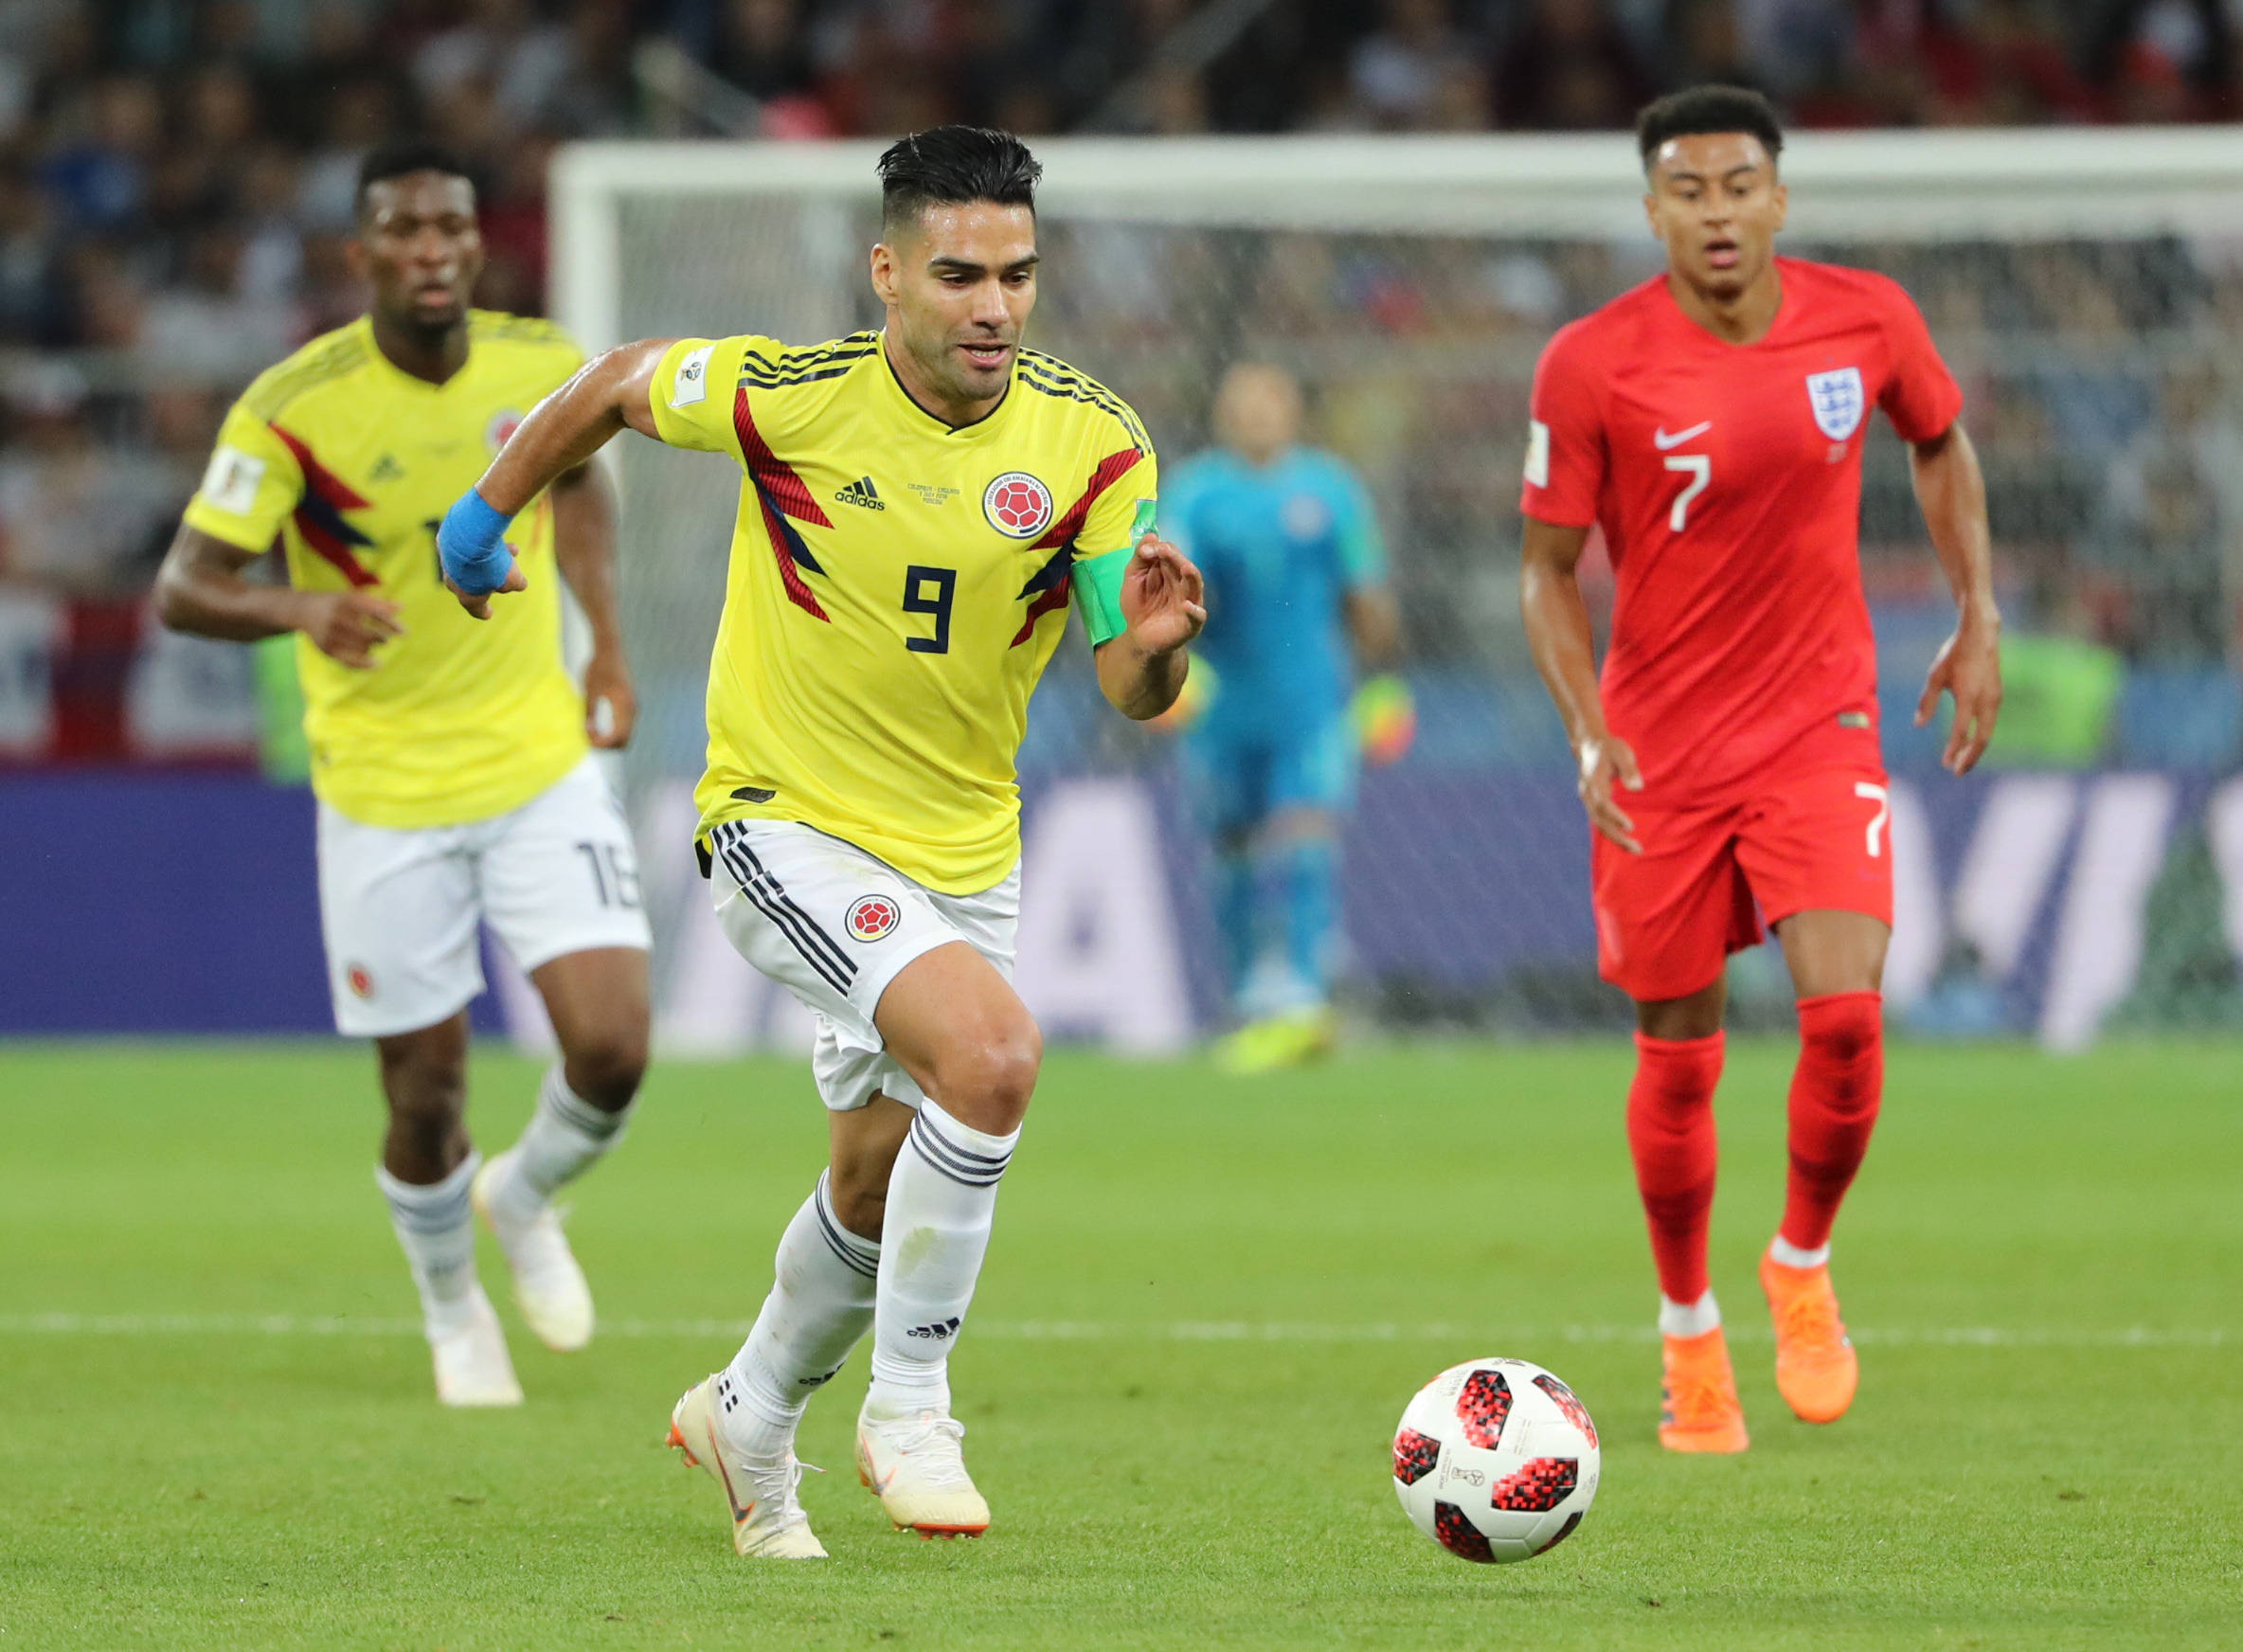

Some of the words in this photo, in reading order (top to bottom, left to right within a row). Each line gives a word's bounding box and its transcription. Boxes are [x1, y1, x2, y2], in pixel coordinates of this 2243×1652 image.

[834, 492, 885, 511] adidas
[1663, 455, 1712, 532] 7
[903, 565, 957, 654] 9
[1854, 781, 1888, 857] 7
